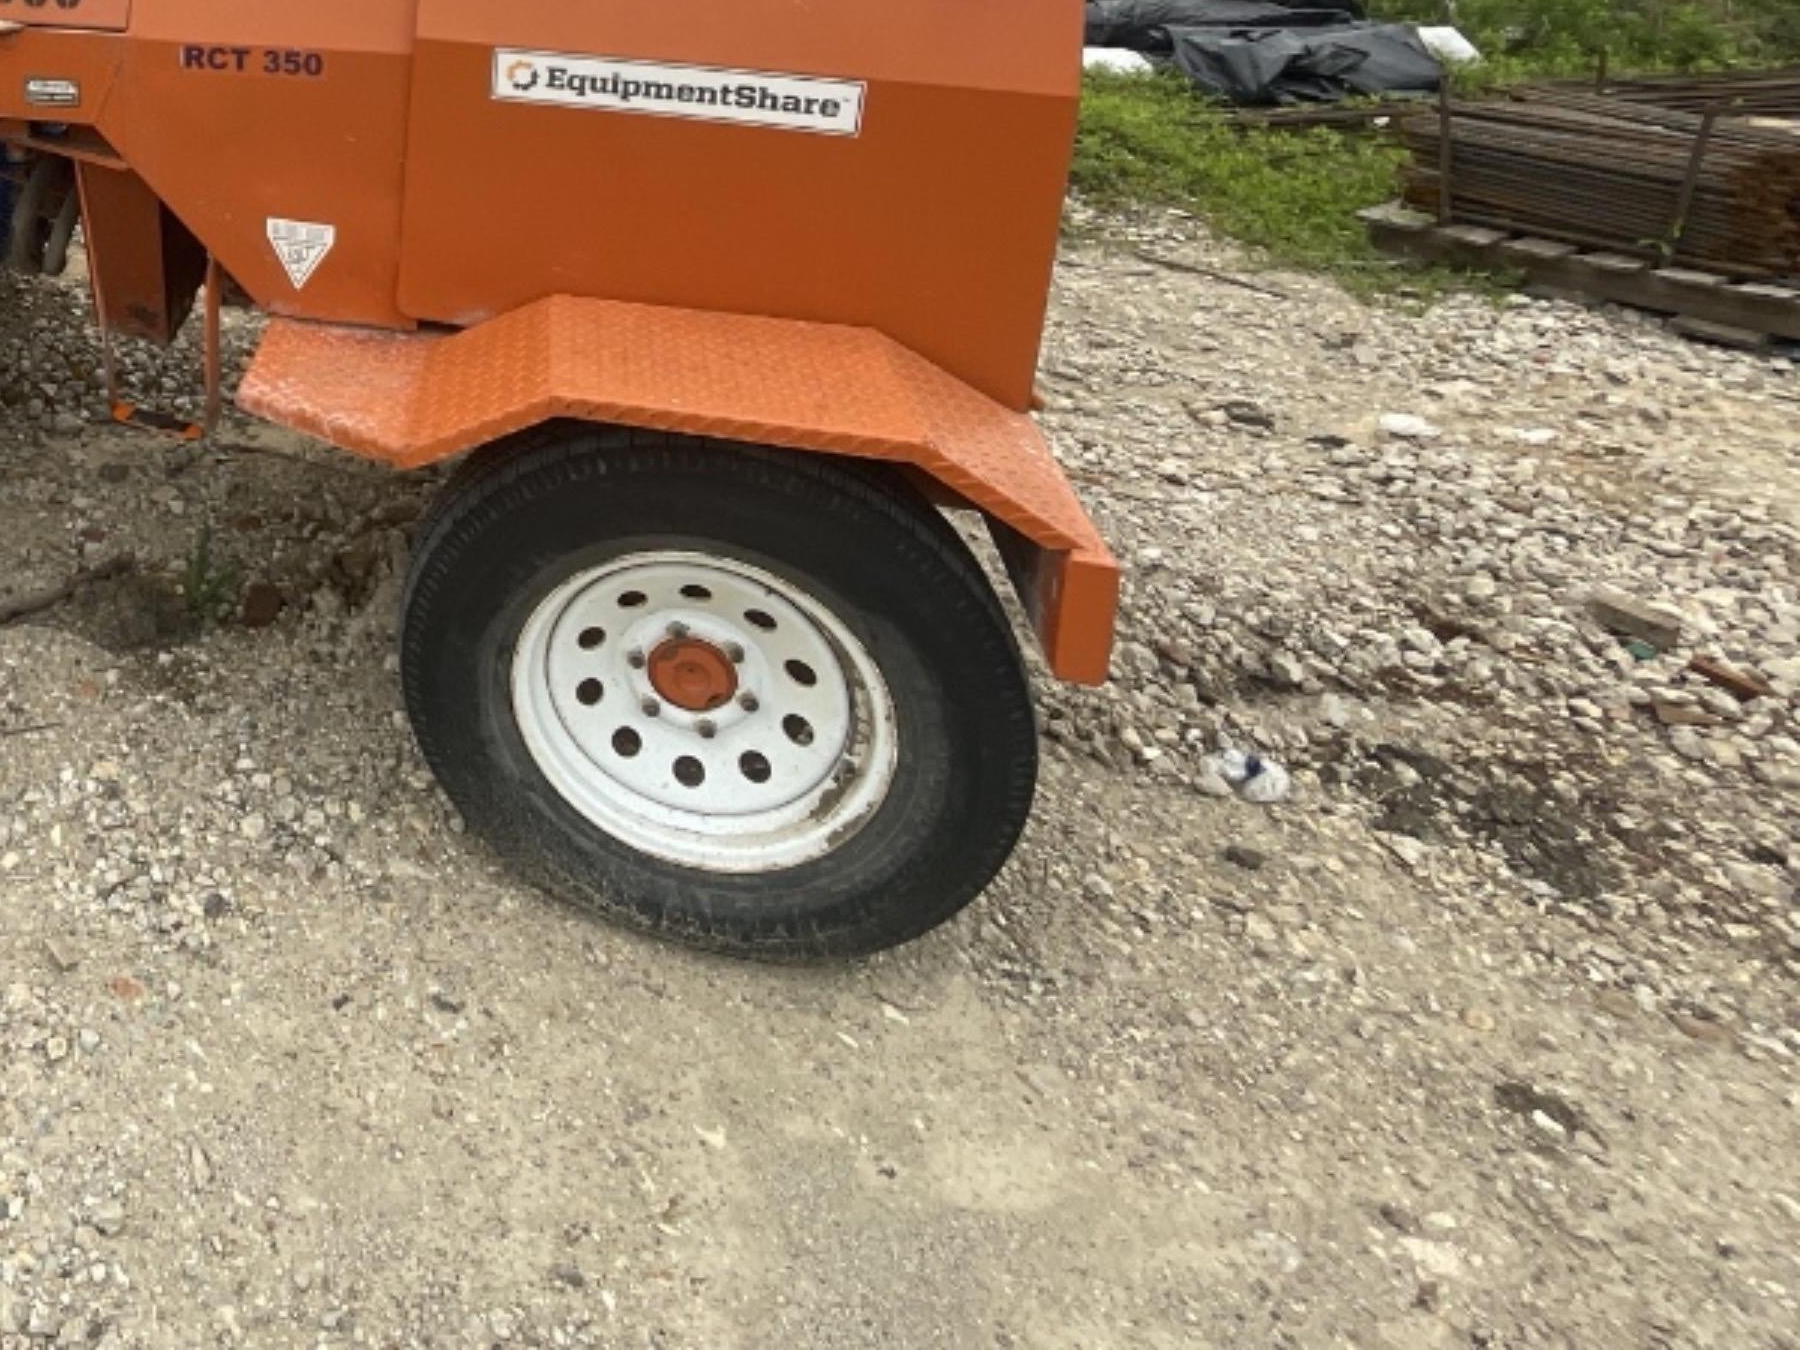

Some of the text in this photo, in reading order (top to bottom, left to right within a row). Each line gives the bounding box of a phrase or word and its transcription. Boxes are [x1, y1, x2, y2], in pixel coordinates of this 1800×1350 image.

[184, 45, 324, 76] RCT 350
[545, 65, 842, 118] EquipmentShare
